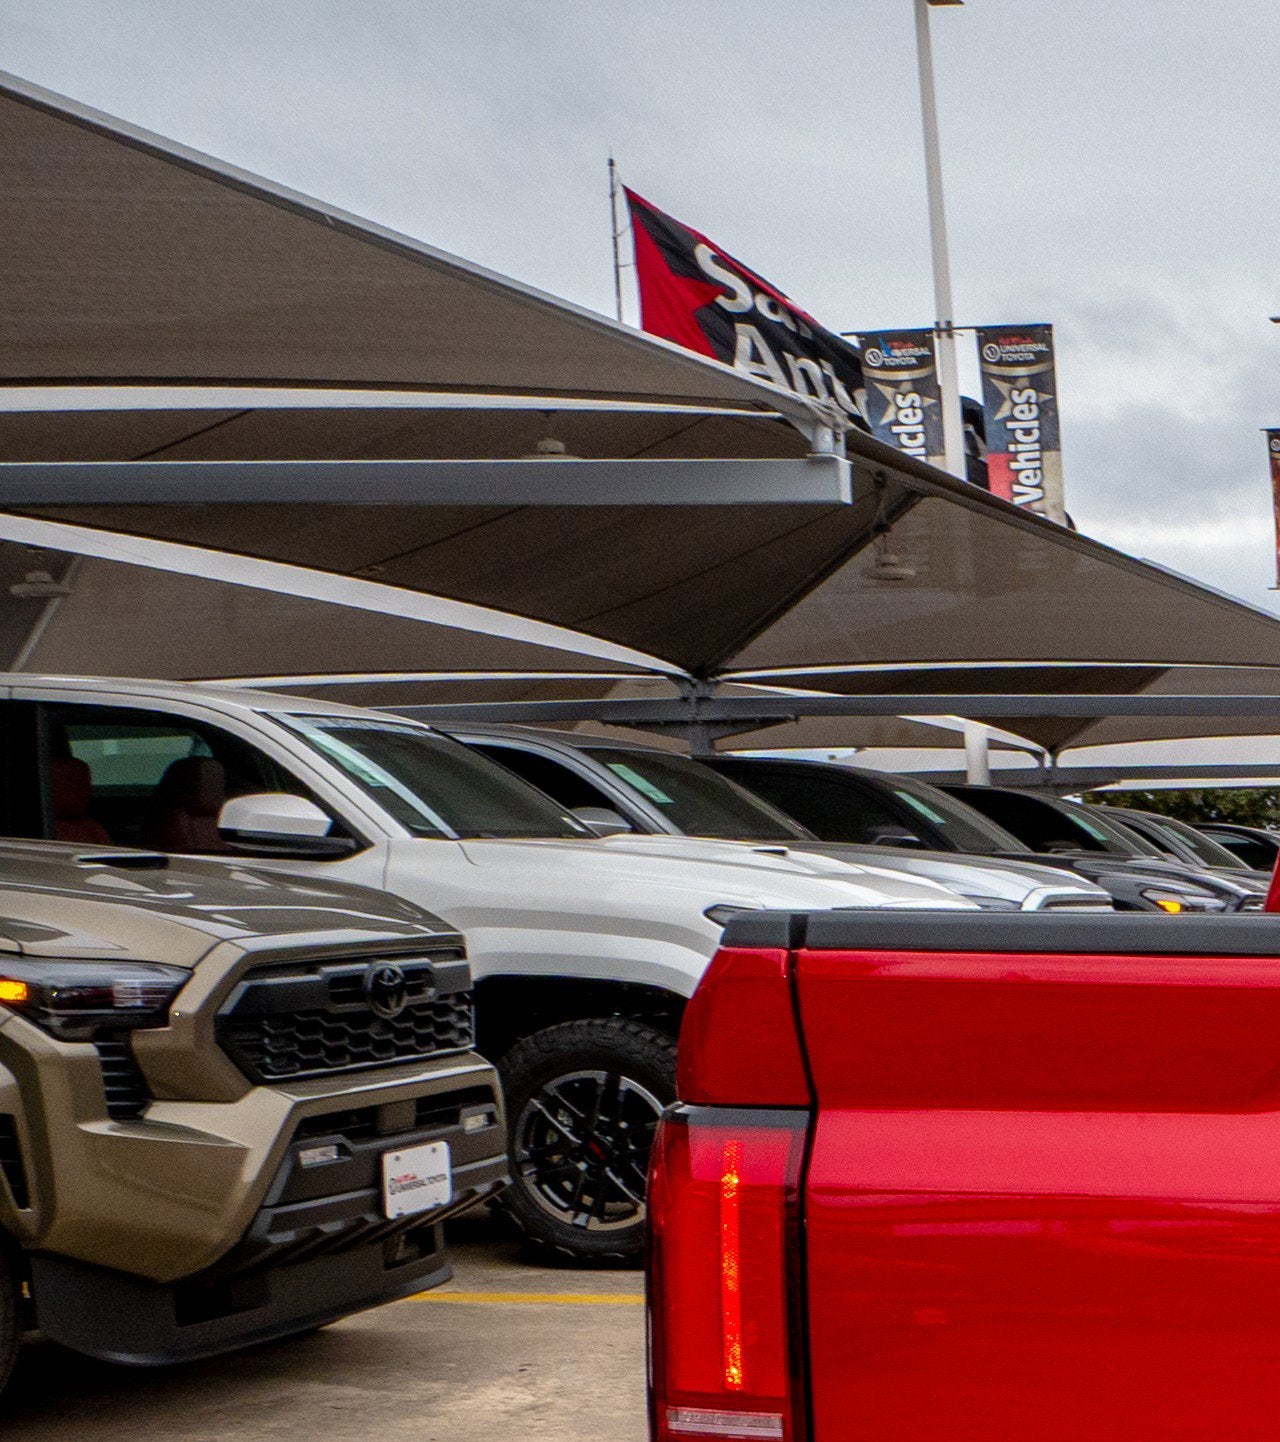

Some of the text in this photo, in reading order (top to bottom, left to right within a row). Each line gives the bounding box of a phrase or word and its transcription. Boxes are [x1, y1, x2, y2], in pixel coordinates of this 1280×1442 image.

[883, 356, 918, 366] TOYOTA
[1001, 352, 1036, 362] TOYOTA
[891, 391, 928, 463] icles
[1008, 388, 1044, 506] Vehicles
